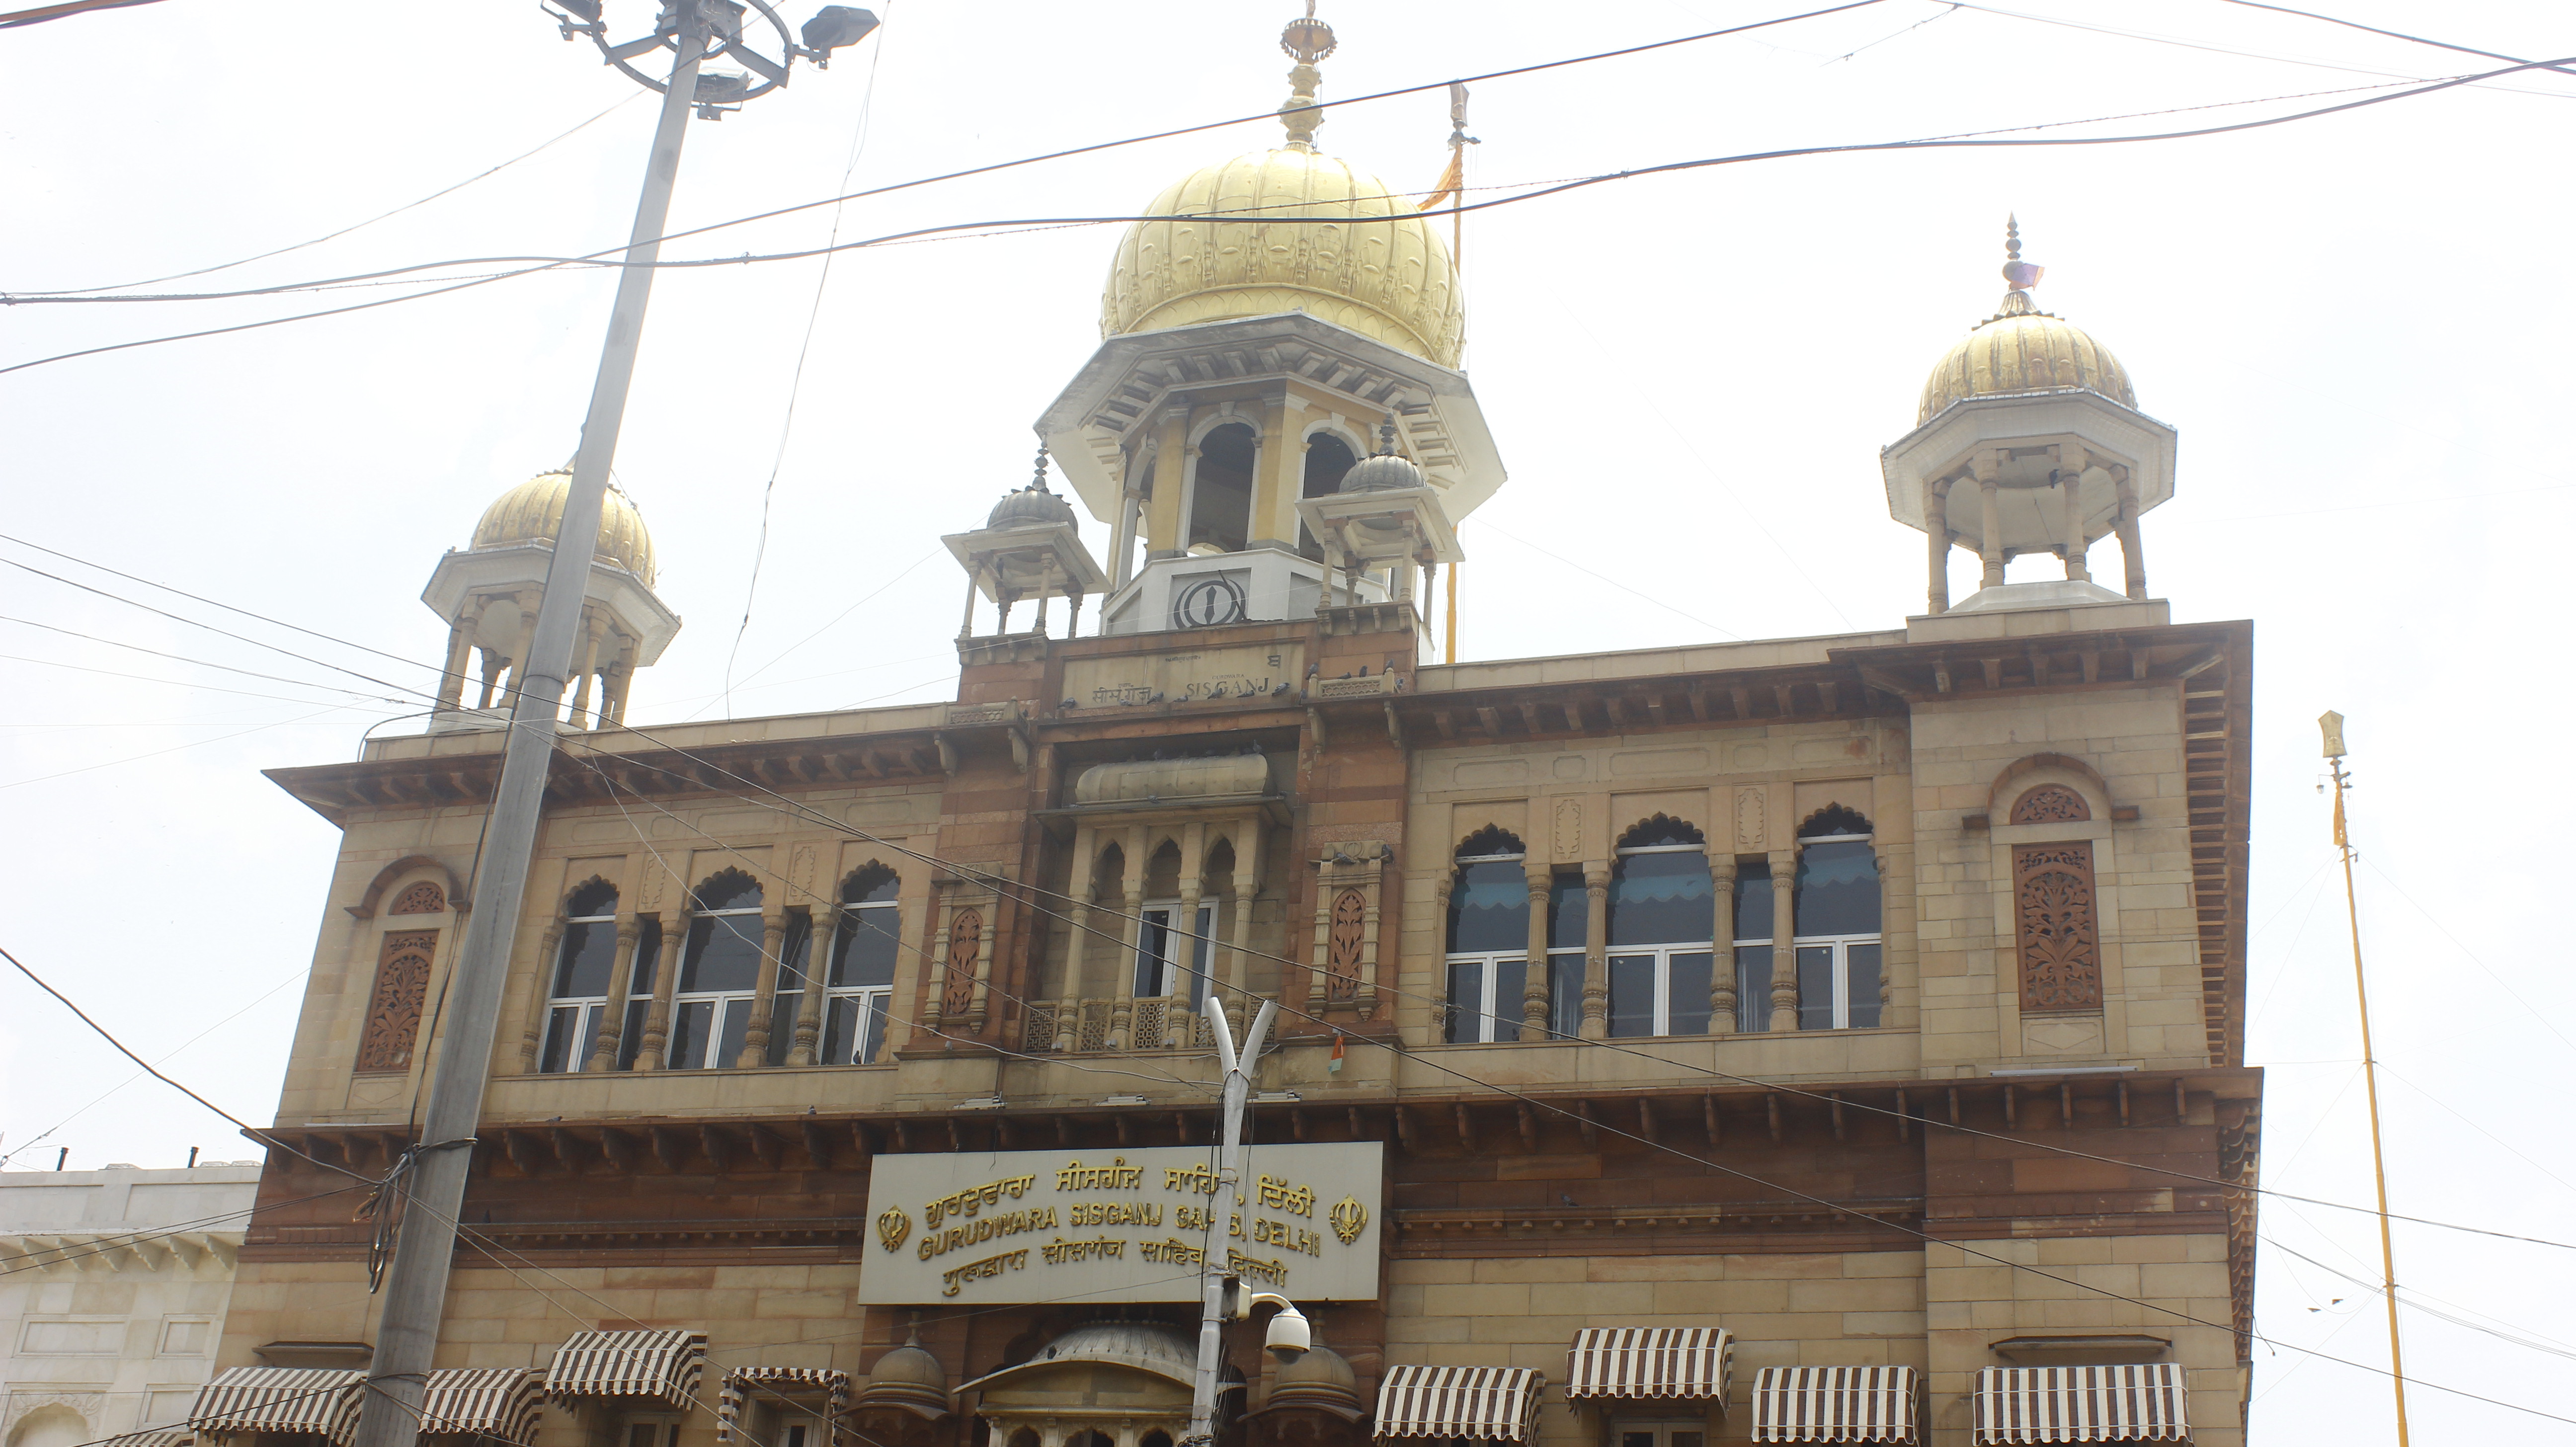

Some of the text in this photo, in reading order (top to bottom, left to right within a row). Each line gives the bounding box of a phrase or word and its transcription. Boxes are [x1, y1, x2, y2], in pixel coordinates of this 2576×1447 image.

[1186, 677, 1269, 696] SISGANJ
[1055, 1156, 1143, 1191] ਸੀਸਗੰਜ
[1257, 1173, 1316, 1217] ਦਿੱਲੀ
[917, 1202, 1319, 1261] GURUDWARA SISGANJ SAHB, DELHI
[1041, 1234, 1127, 1265] सीसगंज
